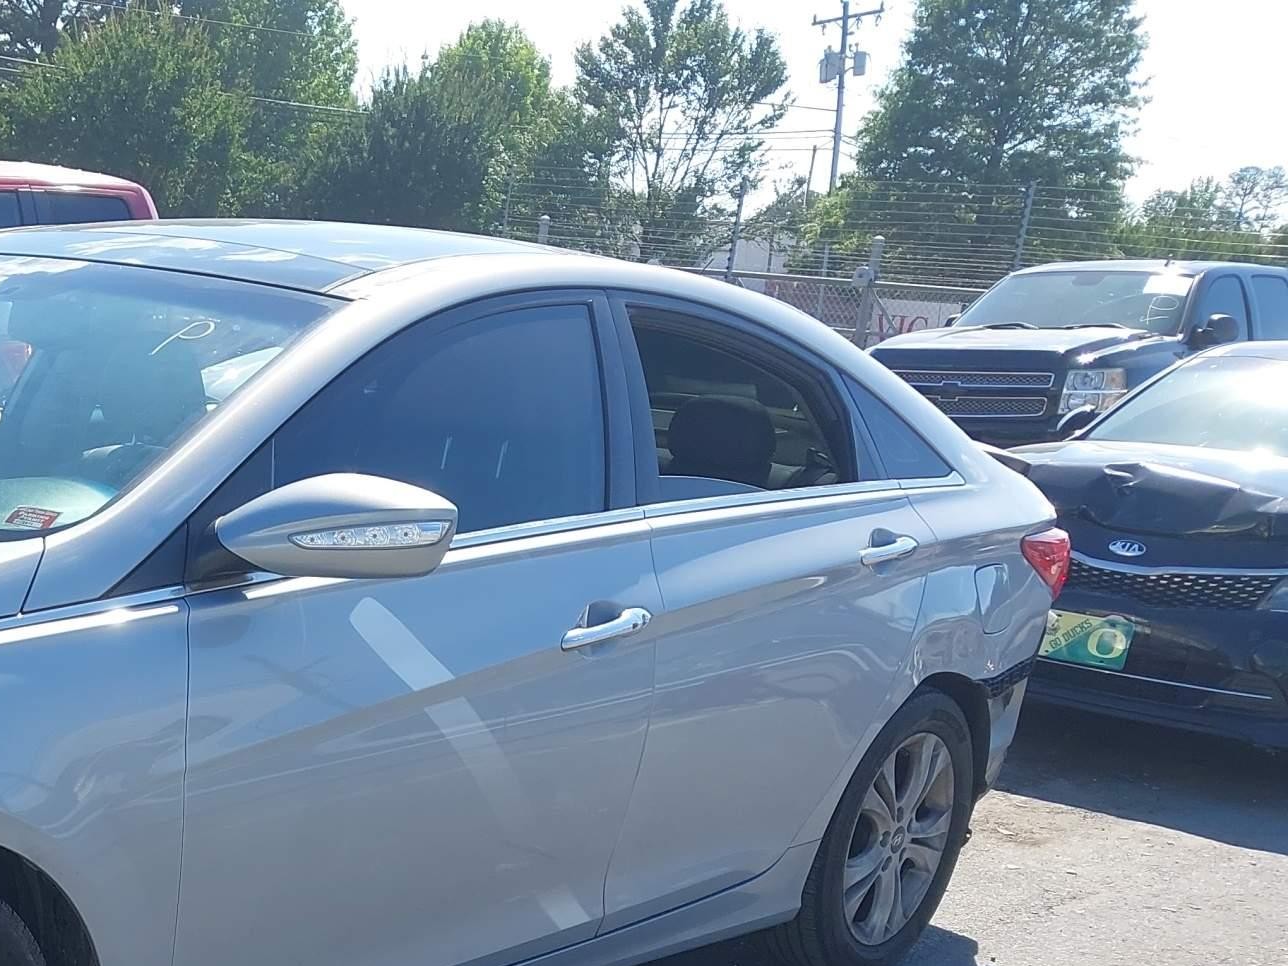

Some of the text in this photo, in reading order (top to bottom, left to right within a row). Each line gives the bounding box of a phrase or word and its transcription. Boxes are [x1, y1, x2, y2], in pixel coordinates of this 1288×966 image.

[1110, 541, 1143, 555] KIA
[1049, 618, 1093, 649] GO DUCKS
